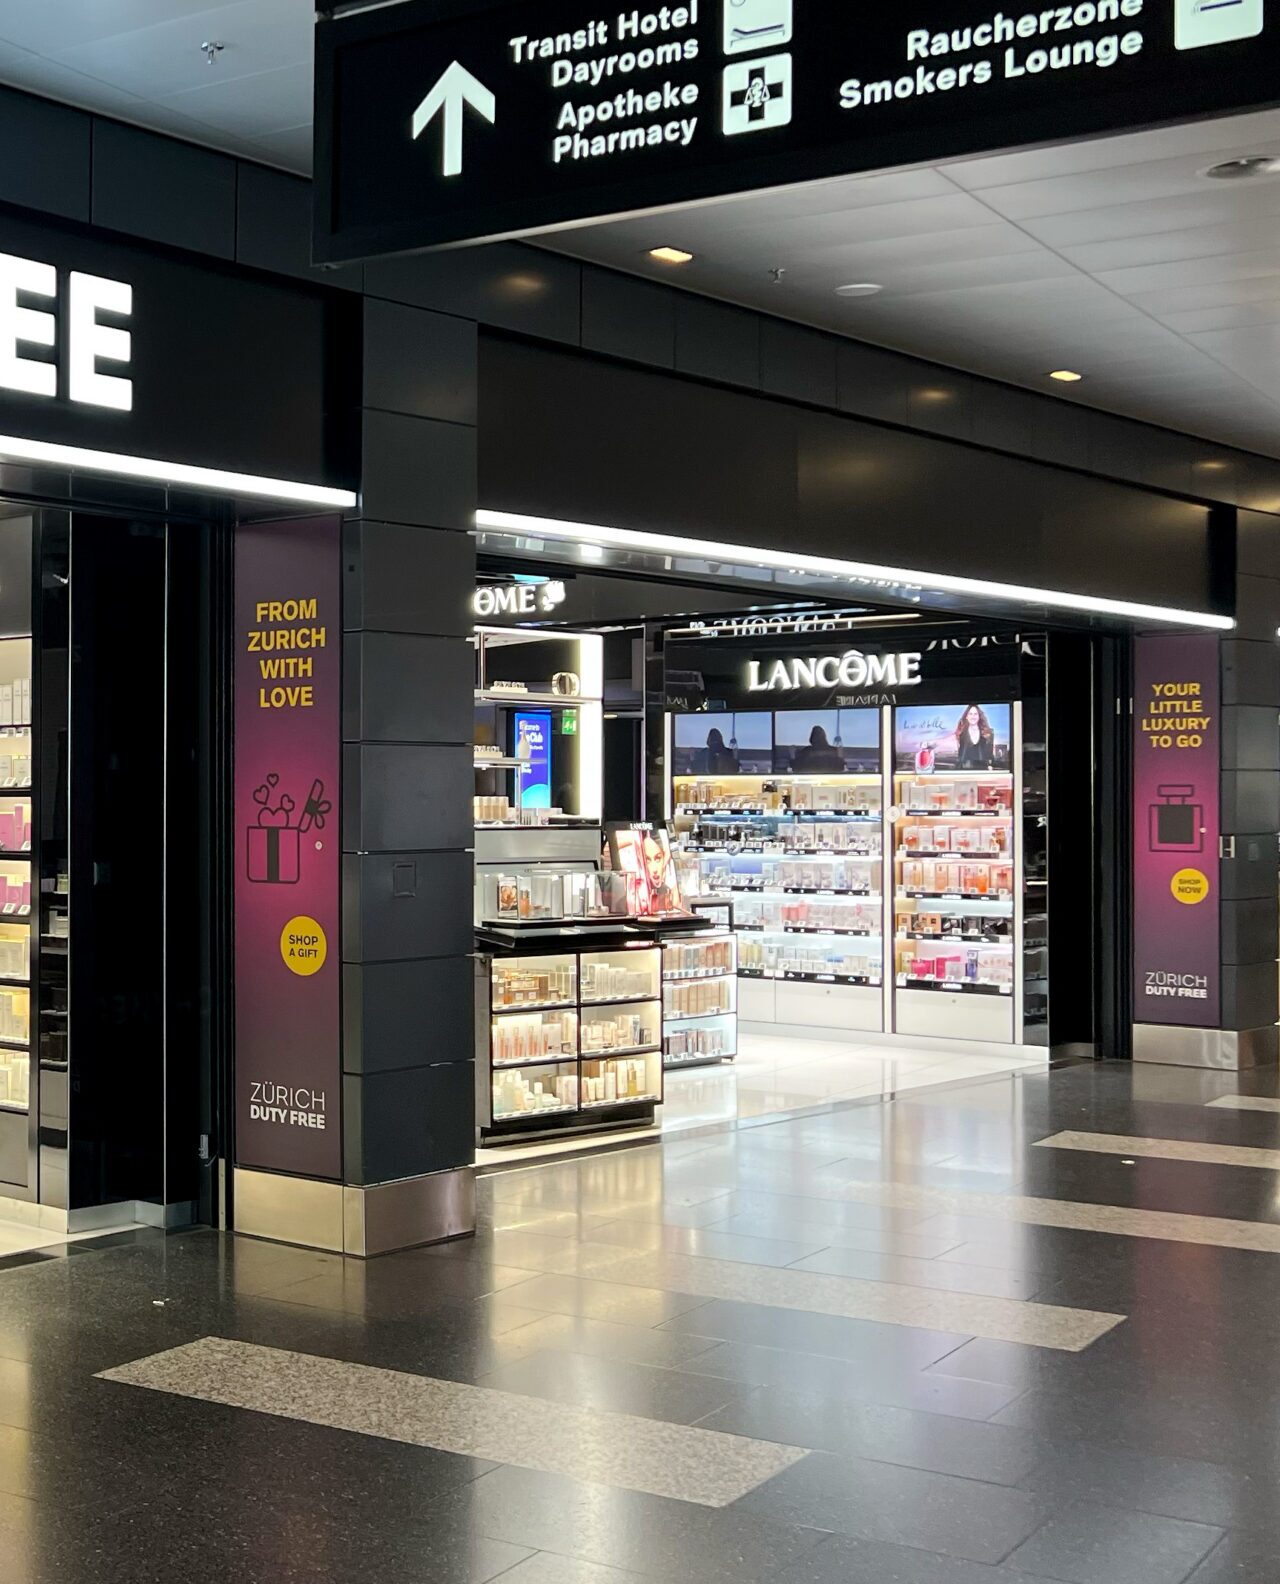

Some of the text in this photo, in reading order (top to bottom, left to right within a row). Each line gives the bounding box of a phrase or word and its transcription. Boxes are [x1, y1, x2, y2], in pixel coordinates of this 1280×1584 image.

[509, 0, 698, 63] Transit Hotel
[907, 0, 1143, 60] Raucherzone
[551, 37, 699, 88] Dayrooms
[838, 30, 1144, 109] Smokers Lounge
[556, 81, 699, 131] Apotheke
[552, 117, 698, 163] Pharmacy
[256, 599, 317, 622] FROM
[247, 627, 326, 652] ZURICH
[260, 657, 313, 680] WITH
[748, 650, 921, 691] LANCÔME
[260, 686, 314, 708] LOVE
[1151, 683, 1201, 697] YOUR
[1150, 700, 1203, 714] LITTLE
[1142, 717, 1211, 731] LUXURY
[1149, 734, 1203, 748] TO GO
[1178, 886, 1201, 894] NOW
[289, 934, 318, 946] SHOP
[289, 948, 319, 959] A GIFT
[1145, 971, 1208, 987] ZÜRICH
[1145, 985, 1208, 999] DUTY FREE
[250, 1081, 325, 1111] ZÜRICH
[250, 1104, 325, 1129] DUTY FREE
